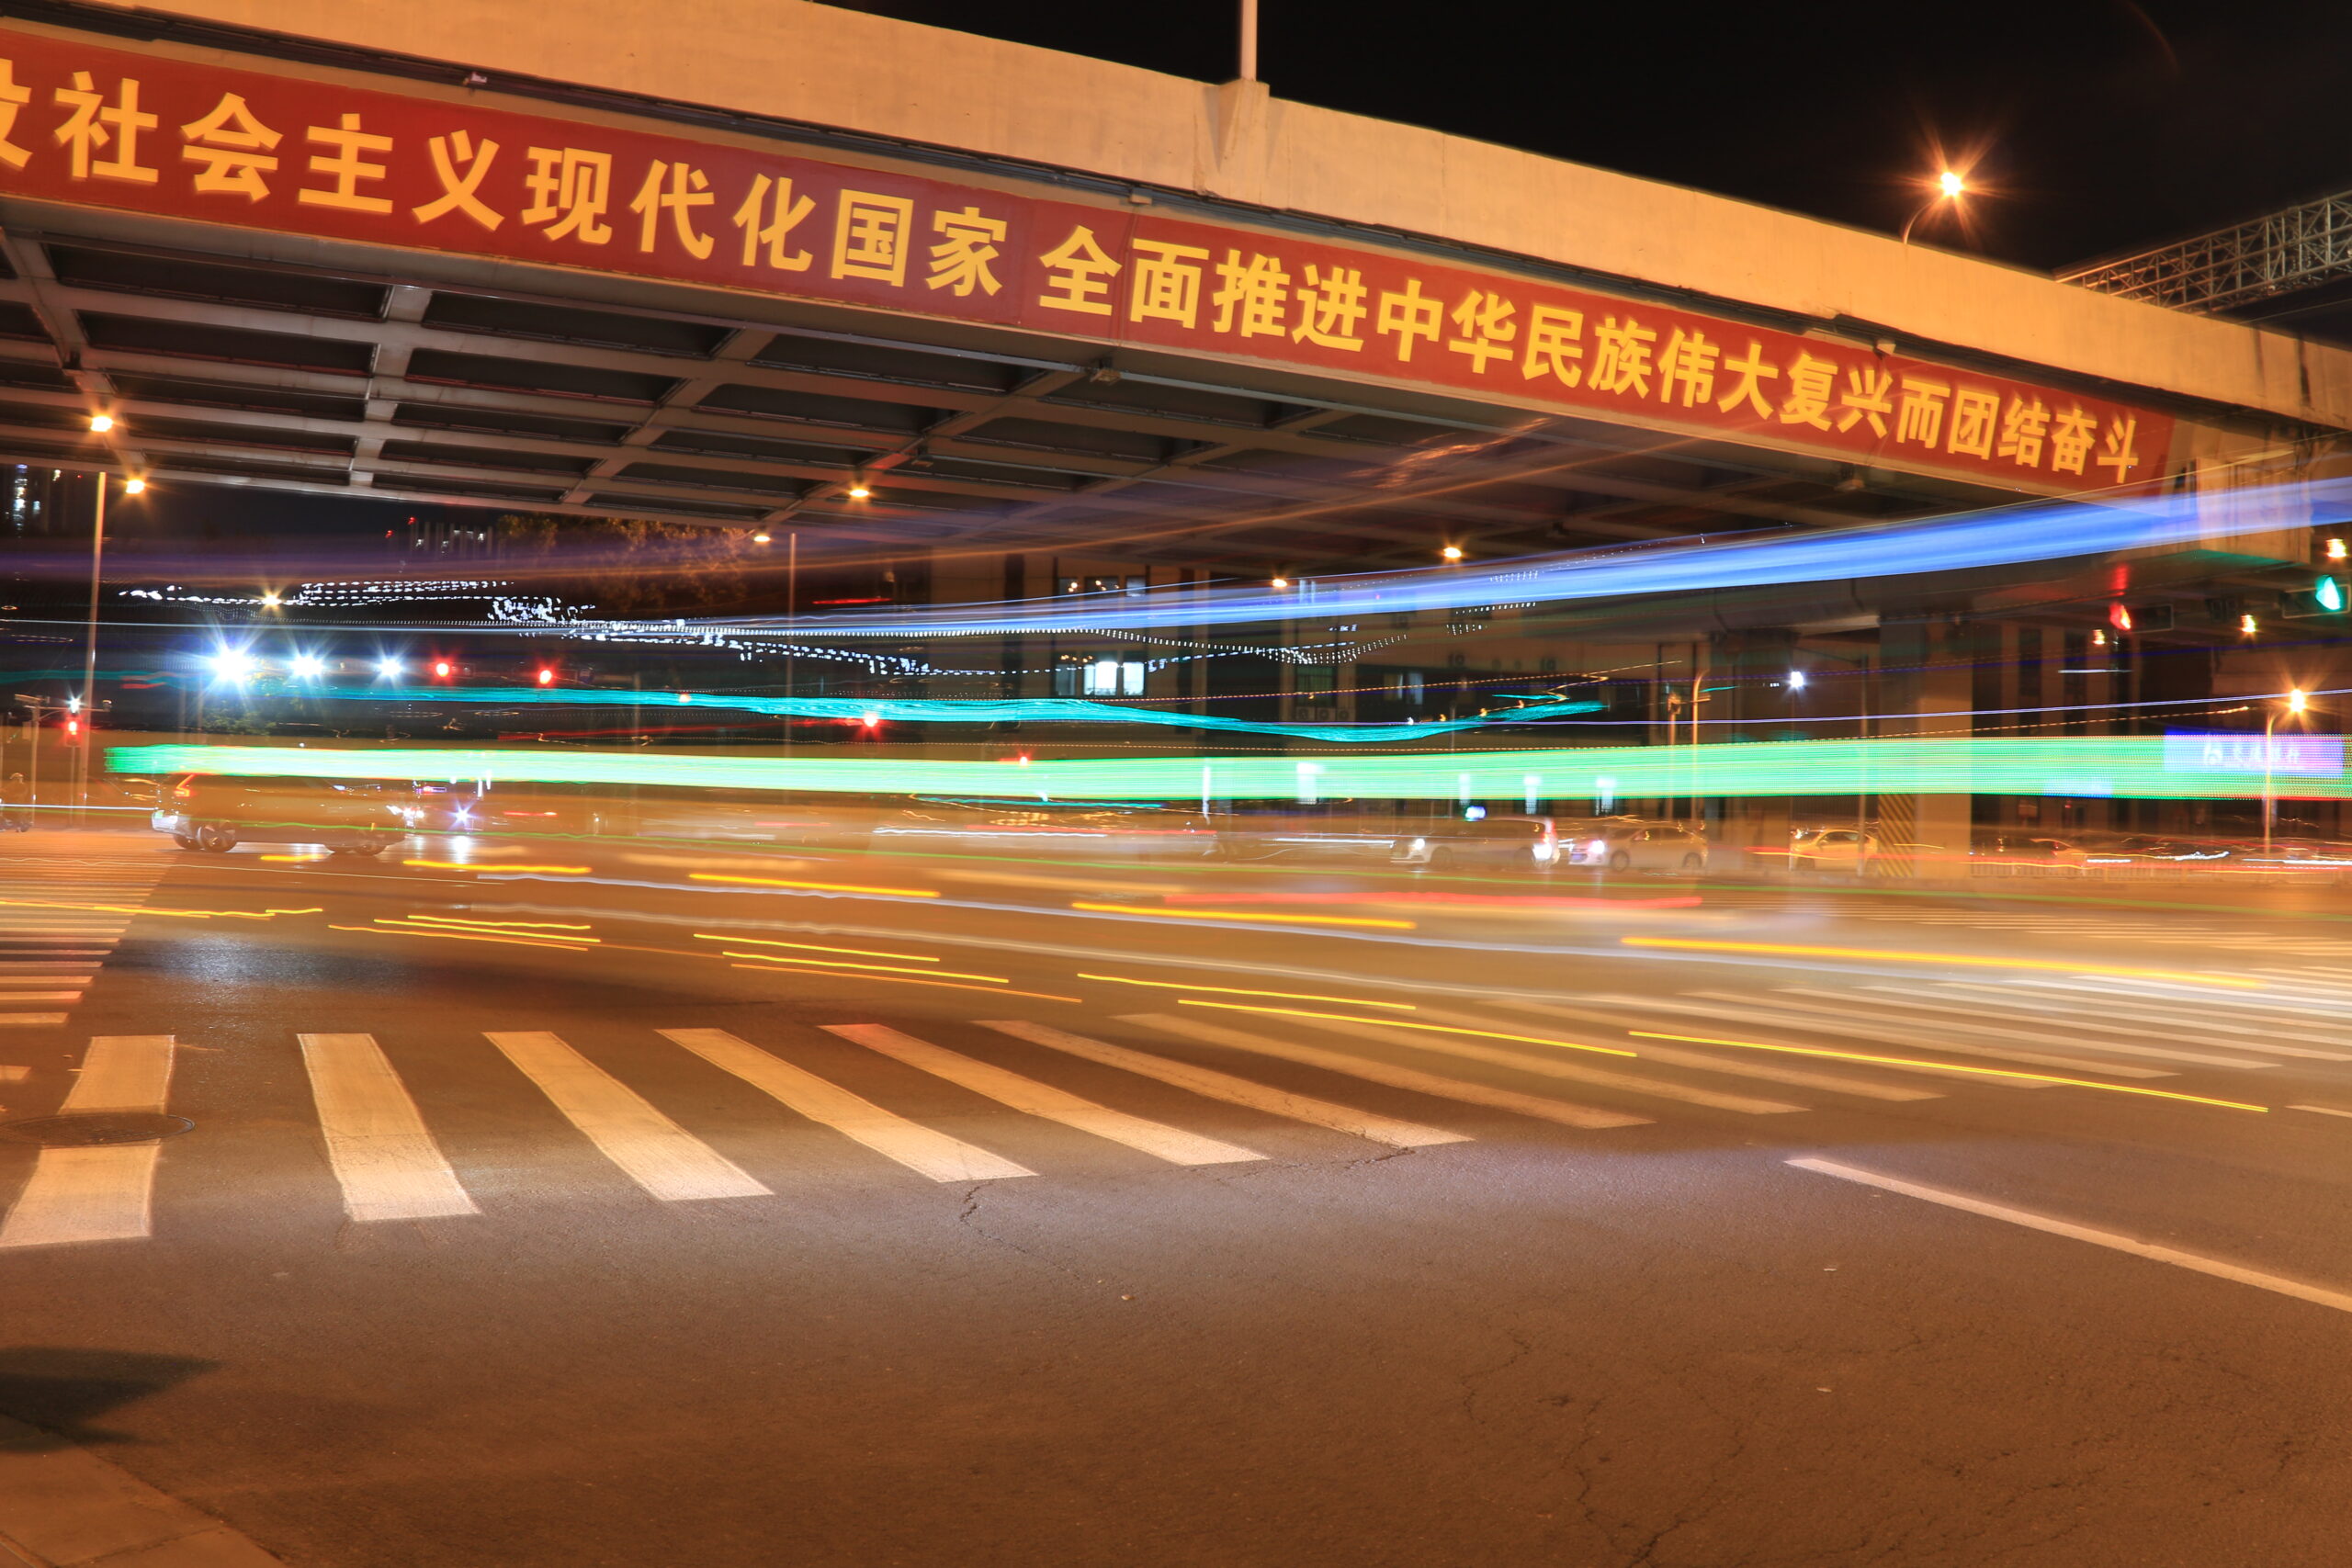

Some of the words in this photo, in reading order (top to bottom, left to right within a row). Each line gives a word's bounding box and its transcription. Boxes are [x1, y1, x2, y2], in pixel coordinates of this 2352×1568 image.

[1039, 225, 2139, 484] 全面推进中华民族伟大复兴而团结奋斗
